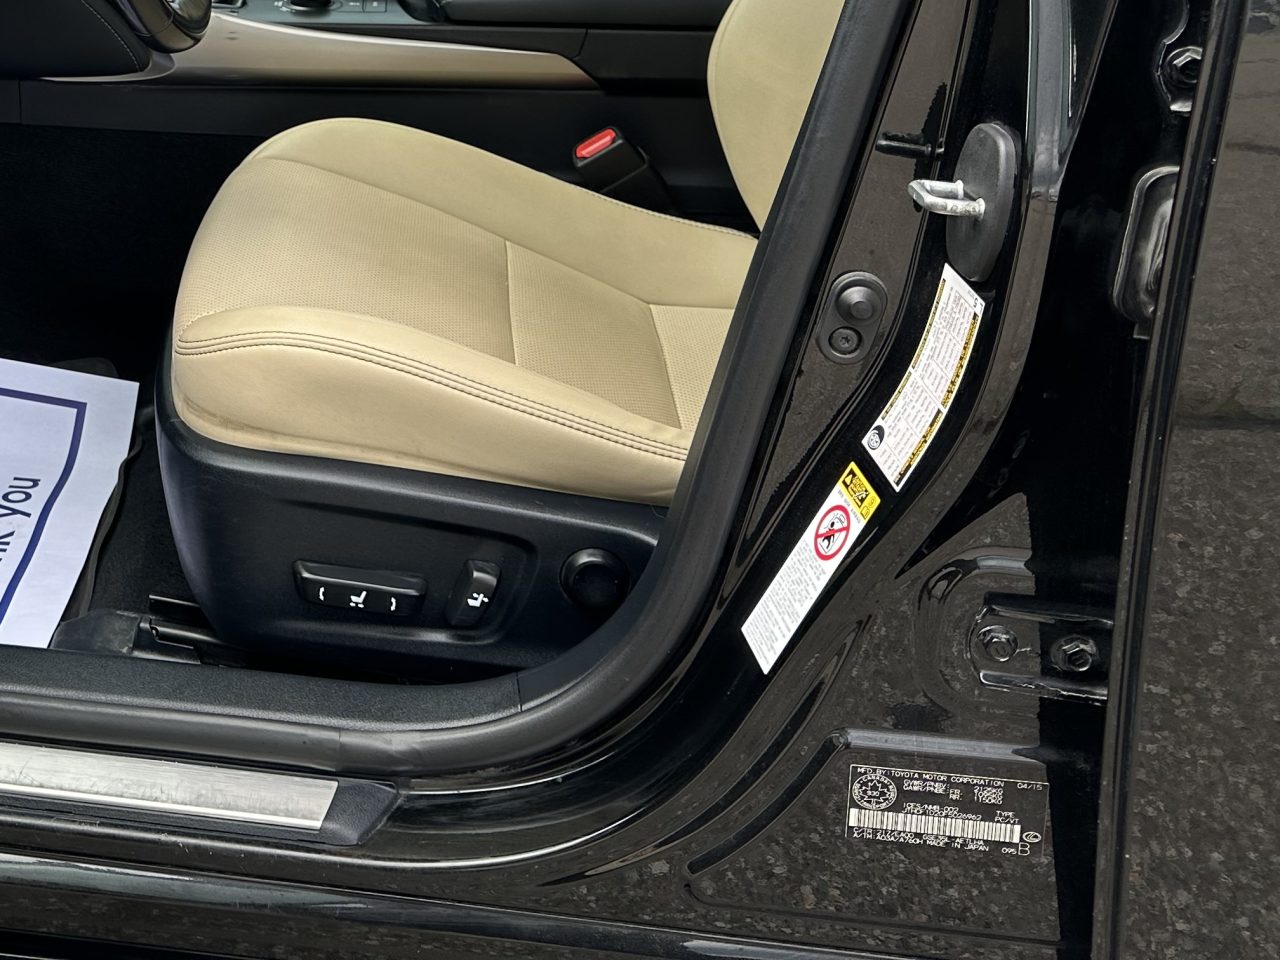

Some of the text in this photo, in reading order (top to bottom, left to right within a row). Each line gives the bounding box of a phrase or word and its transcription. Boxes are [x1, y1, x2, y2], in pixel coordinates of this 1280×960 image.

[891, 771, 919, 779] TOYOTA
[950, 776, 1005, 787] CORPORATION
[996, 810, 1016, 818] TYPE
[926, 840, 946, 848] MADE
[964, 844, 990, 852] JAPAN
[1018, 842, 1030, 856] B
